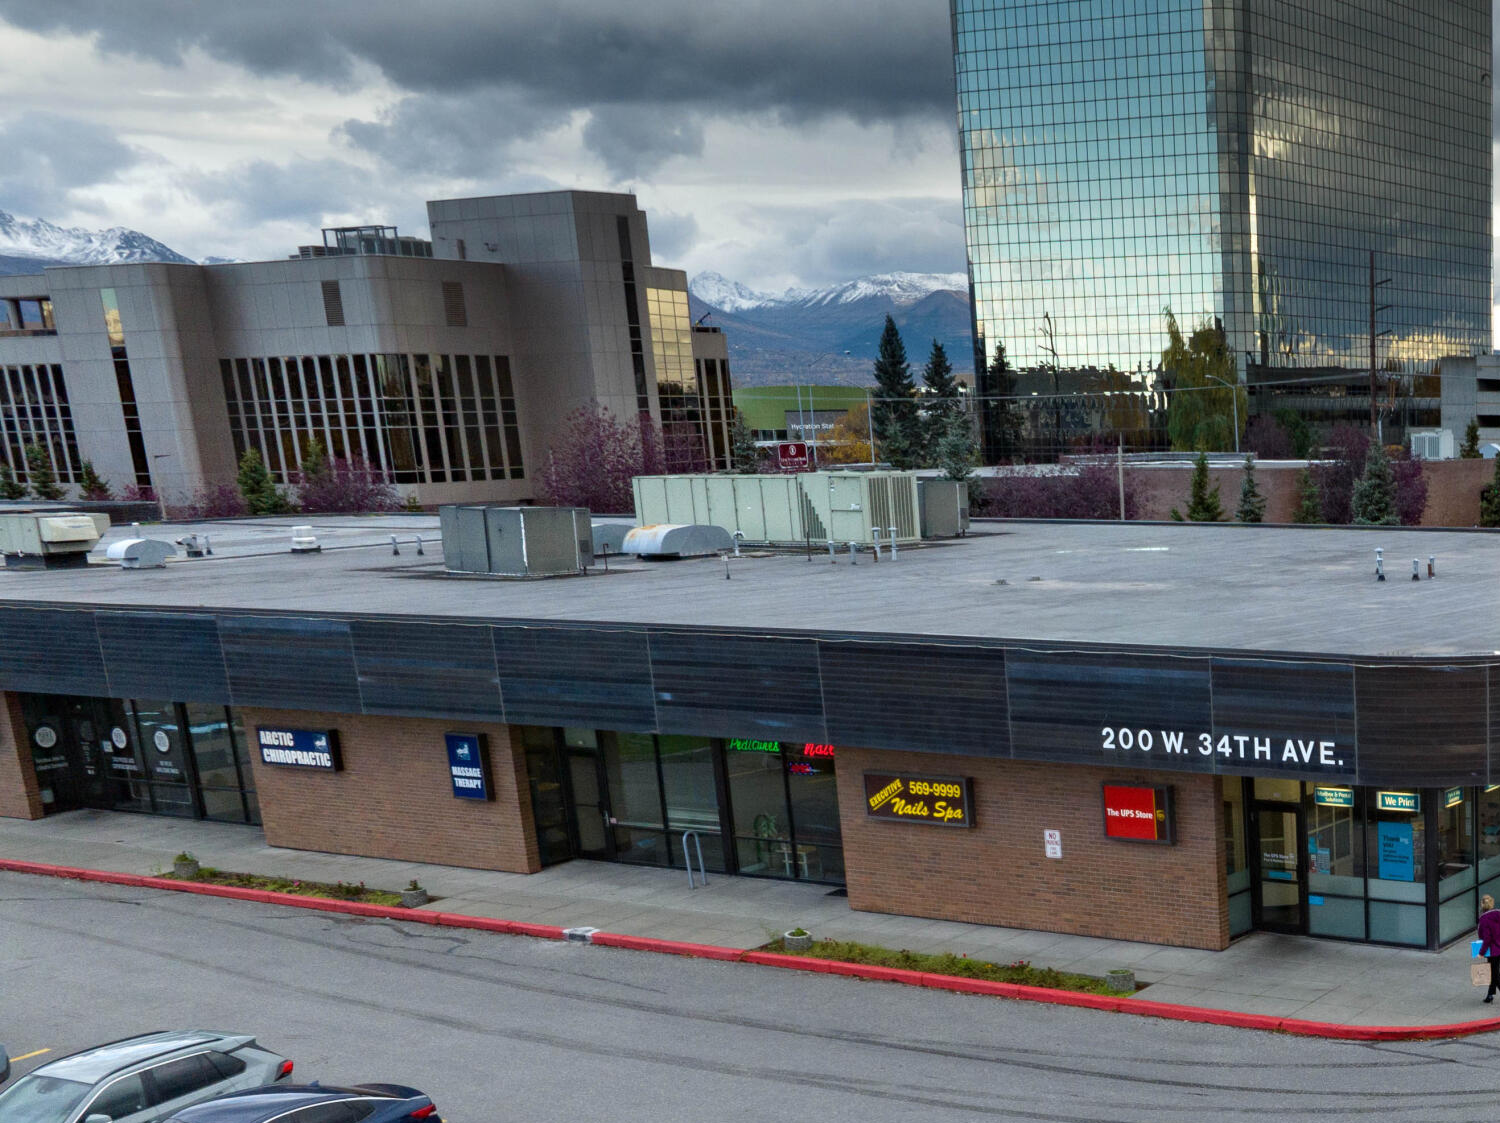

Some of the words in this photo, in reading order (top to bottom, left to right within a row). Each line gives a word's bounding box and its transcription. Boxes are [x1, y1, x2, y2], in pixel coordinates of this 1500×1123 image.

[259, 730, 294, 747] ARCTIC
[1101, 727, 1153, 751] 200
[1161, 730, 1189, 754] W.
[1198, 733, 1271, 760] 34TH
[1282, 739, 1344, 766] AVE.
[262, 748, 332, 767] CHIROPRACTIC
[451, 766, 482, 777] MASSAGE
[455, 777, 482, 789] THERAPY
[909, 781, 961, 798] 569-9999
[869, 778, 902, 807] EXECUTIVE
[890, 797, 929, 816] Nails
[933, 801, 964, 822] Spa
[1384, 796, 1396, 806] We
[1398, 796, 1415, 807] Print
[1106, 808, 1119, 817] The
[1120, 809, 1134, 818] UPS
[1136, 810, 1153, 819] Store
[1048, 832, 1056, 840] NO
